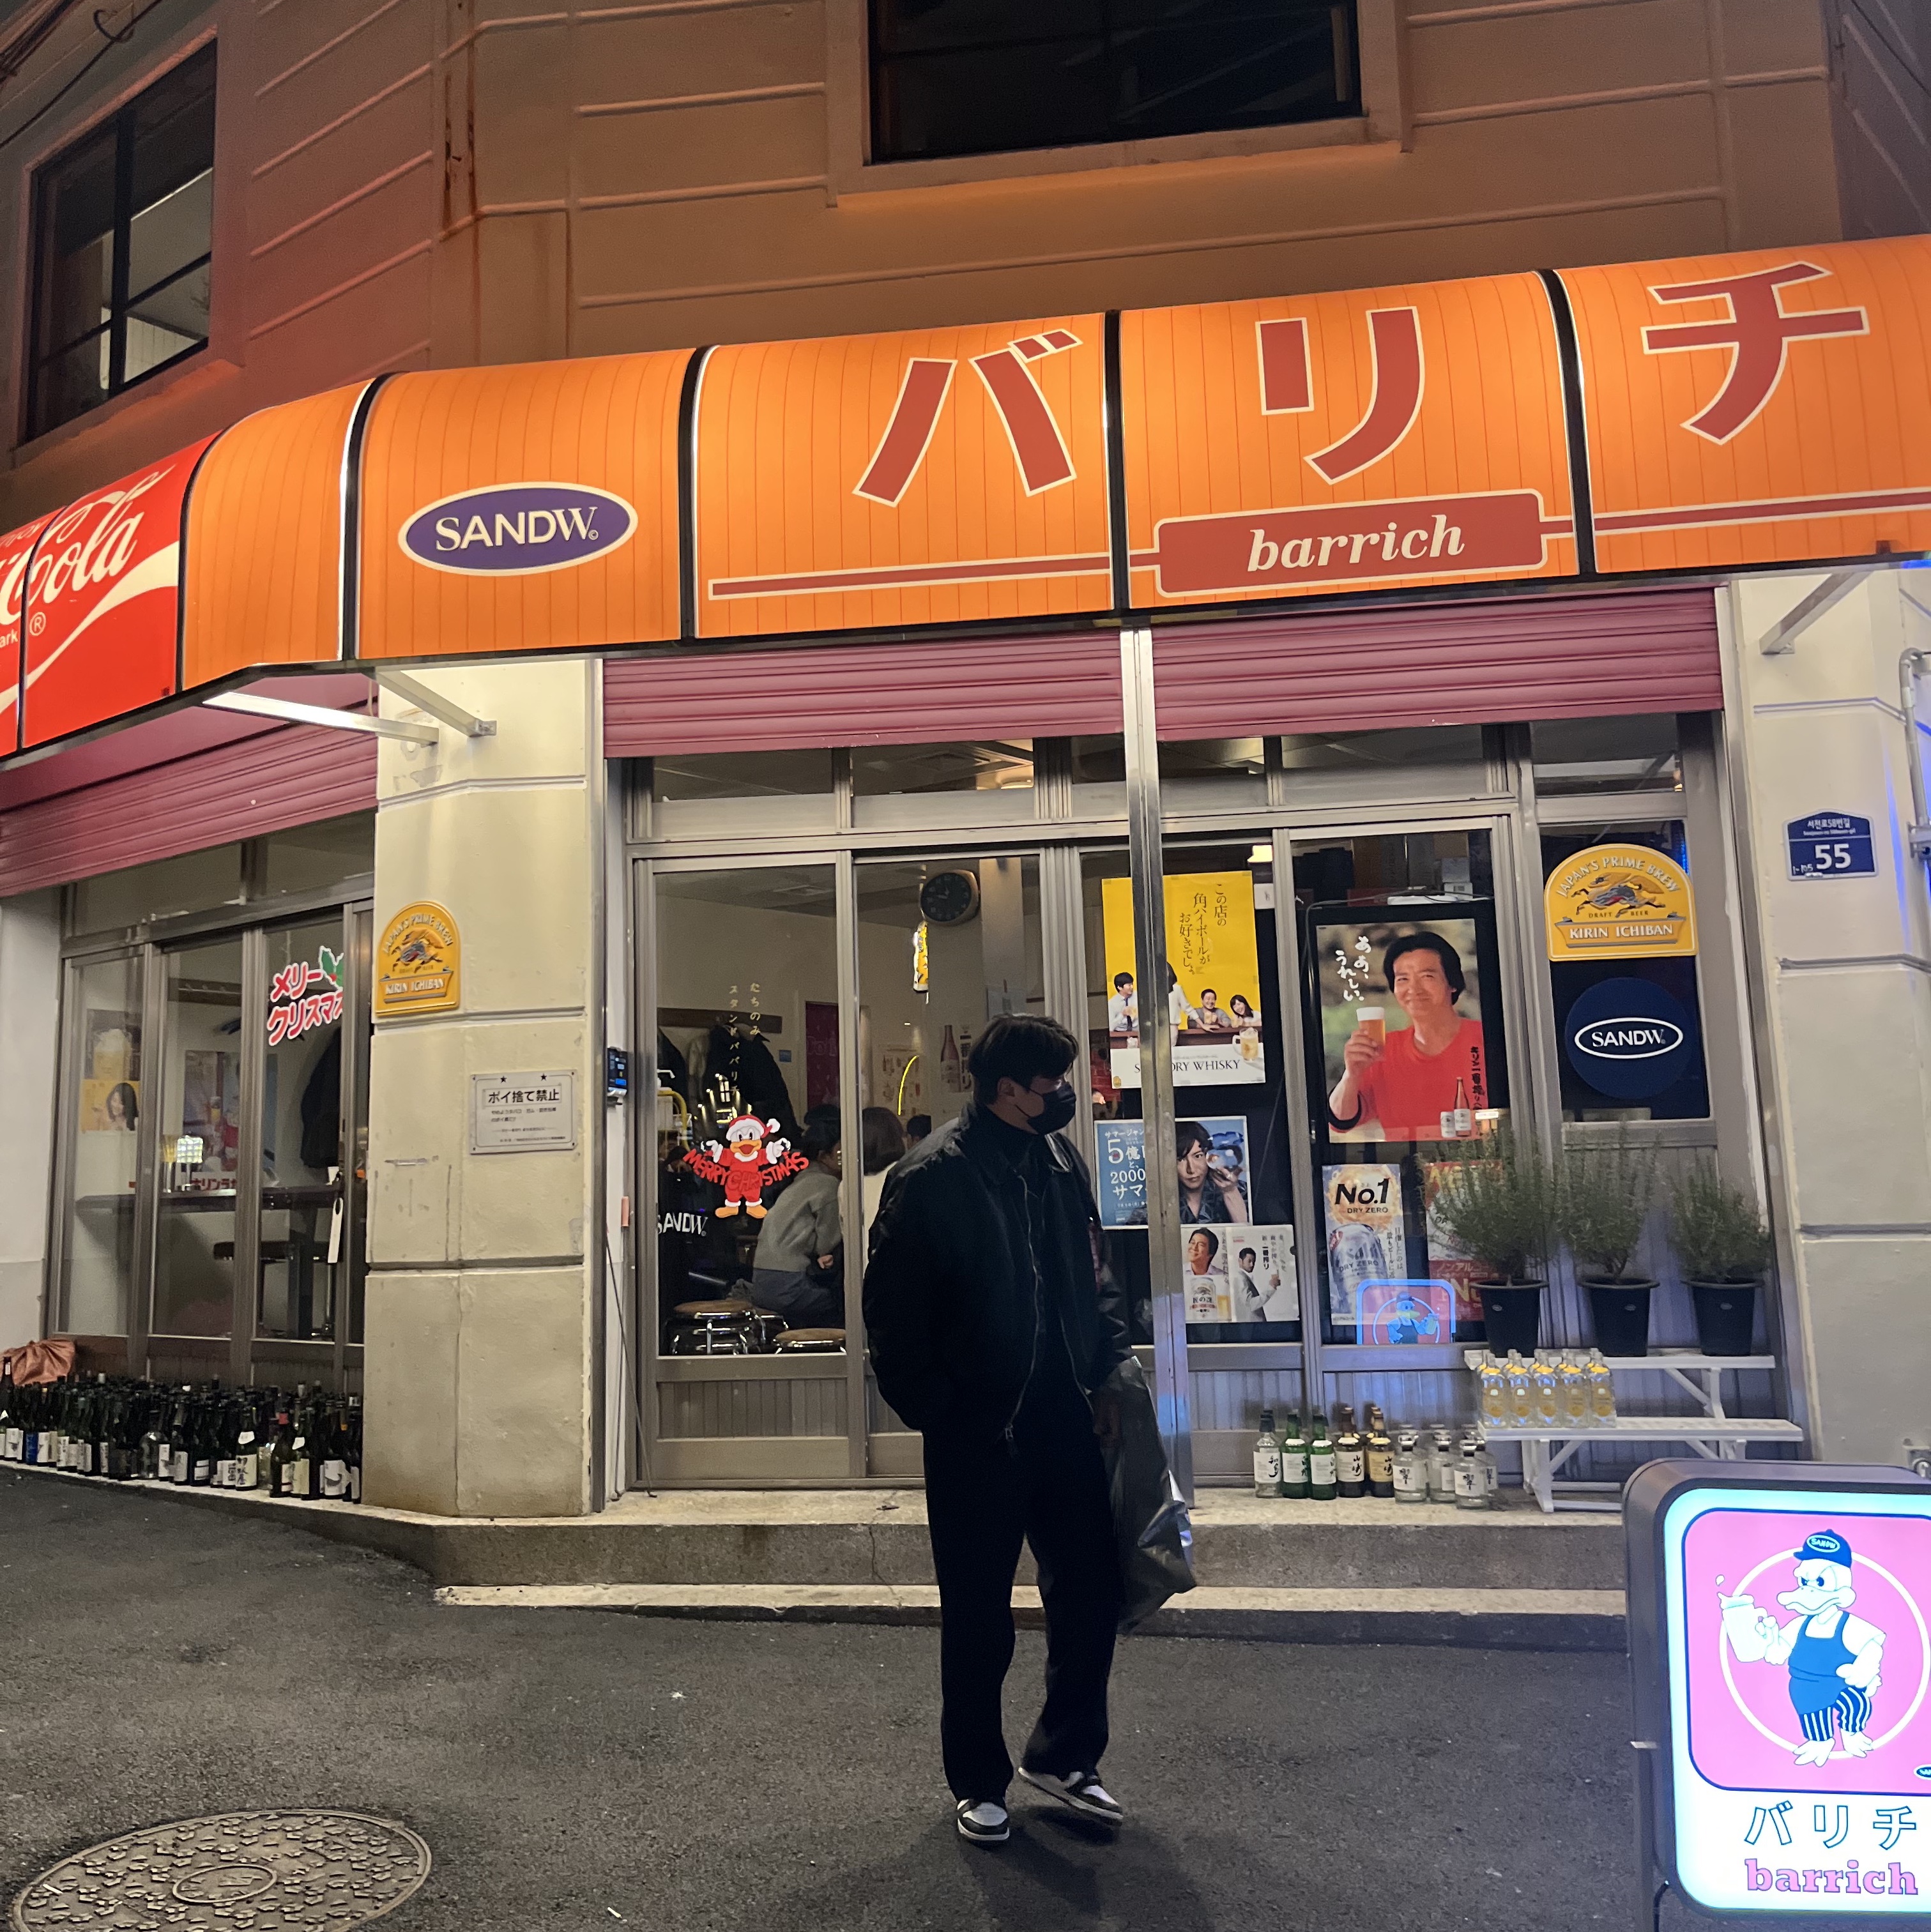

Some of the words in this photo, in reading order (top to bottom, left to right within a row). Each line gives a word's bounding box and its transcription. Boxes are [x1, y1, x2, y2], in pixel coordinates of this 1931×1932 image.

[852, 261, 1870, 507] バリチ
[1247, 513, 1465, 573] barrich
[1556, 860, 1599, 898] JAPAN'S
[1602, 856, 1645, 871] PRIME
[1647, 864, 1681, 892] BREW
[1815, 843, 1851, 870] 55
[1215, 883, 1228, 926] この店の
[411, 913, 435, 927] PRIME
[436, 920, 454, 946] BREW
[1194, 892, 1210, 965] 角ハイボールが
[1569, 927, 1608, 939] KIRIN
[1615, 924, 1674, 938] ICHIBAN
[270, 961, 323, 1003] メリー
[386, 982, 408, 994] KIRIN
[411, 978, 445, 991] ICHIBAN
[750, 982, 761, 1036] たちのみ
[1193, 1060, 1240, 1071] WHISKY
[488, 1088, 560, 1104] ポイ捨て禁止
[682, 1148, 731, 1186] MERRY
[726, 1152, 809, 1192] CHRISTMAS
[1334, 1178, 1390, 1205] No.1
[1744, 1800, 1917, 1850] バリチ
[1744, 1858, 1919, 1896] barrich
